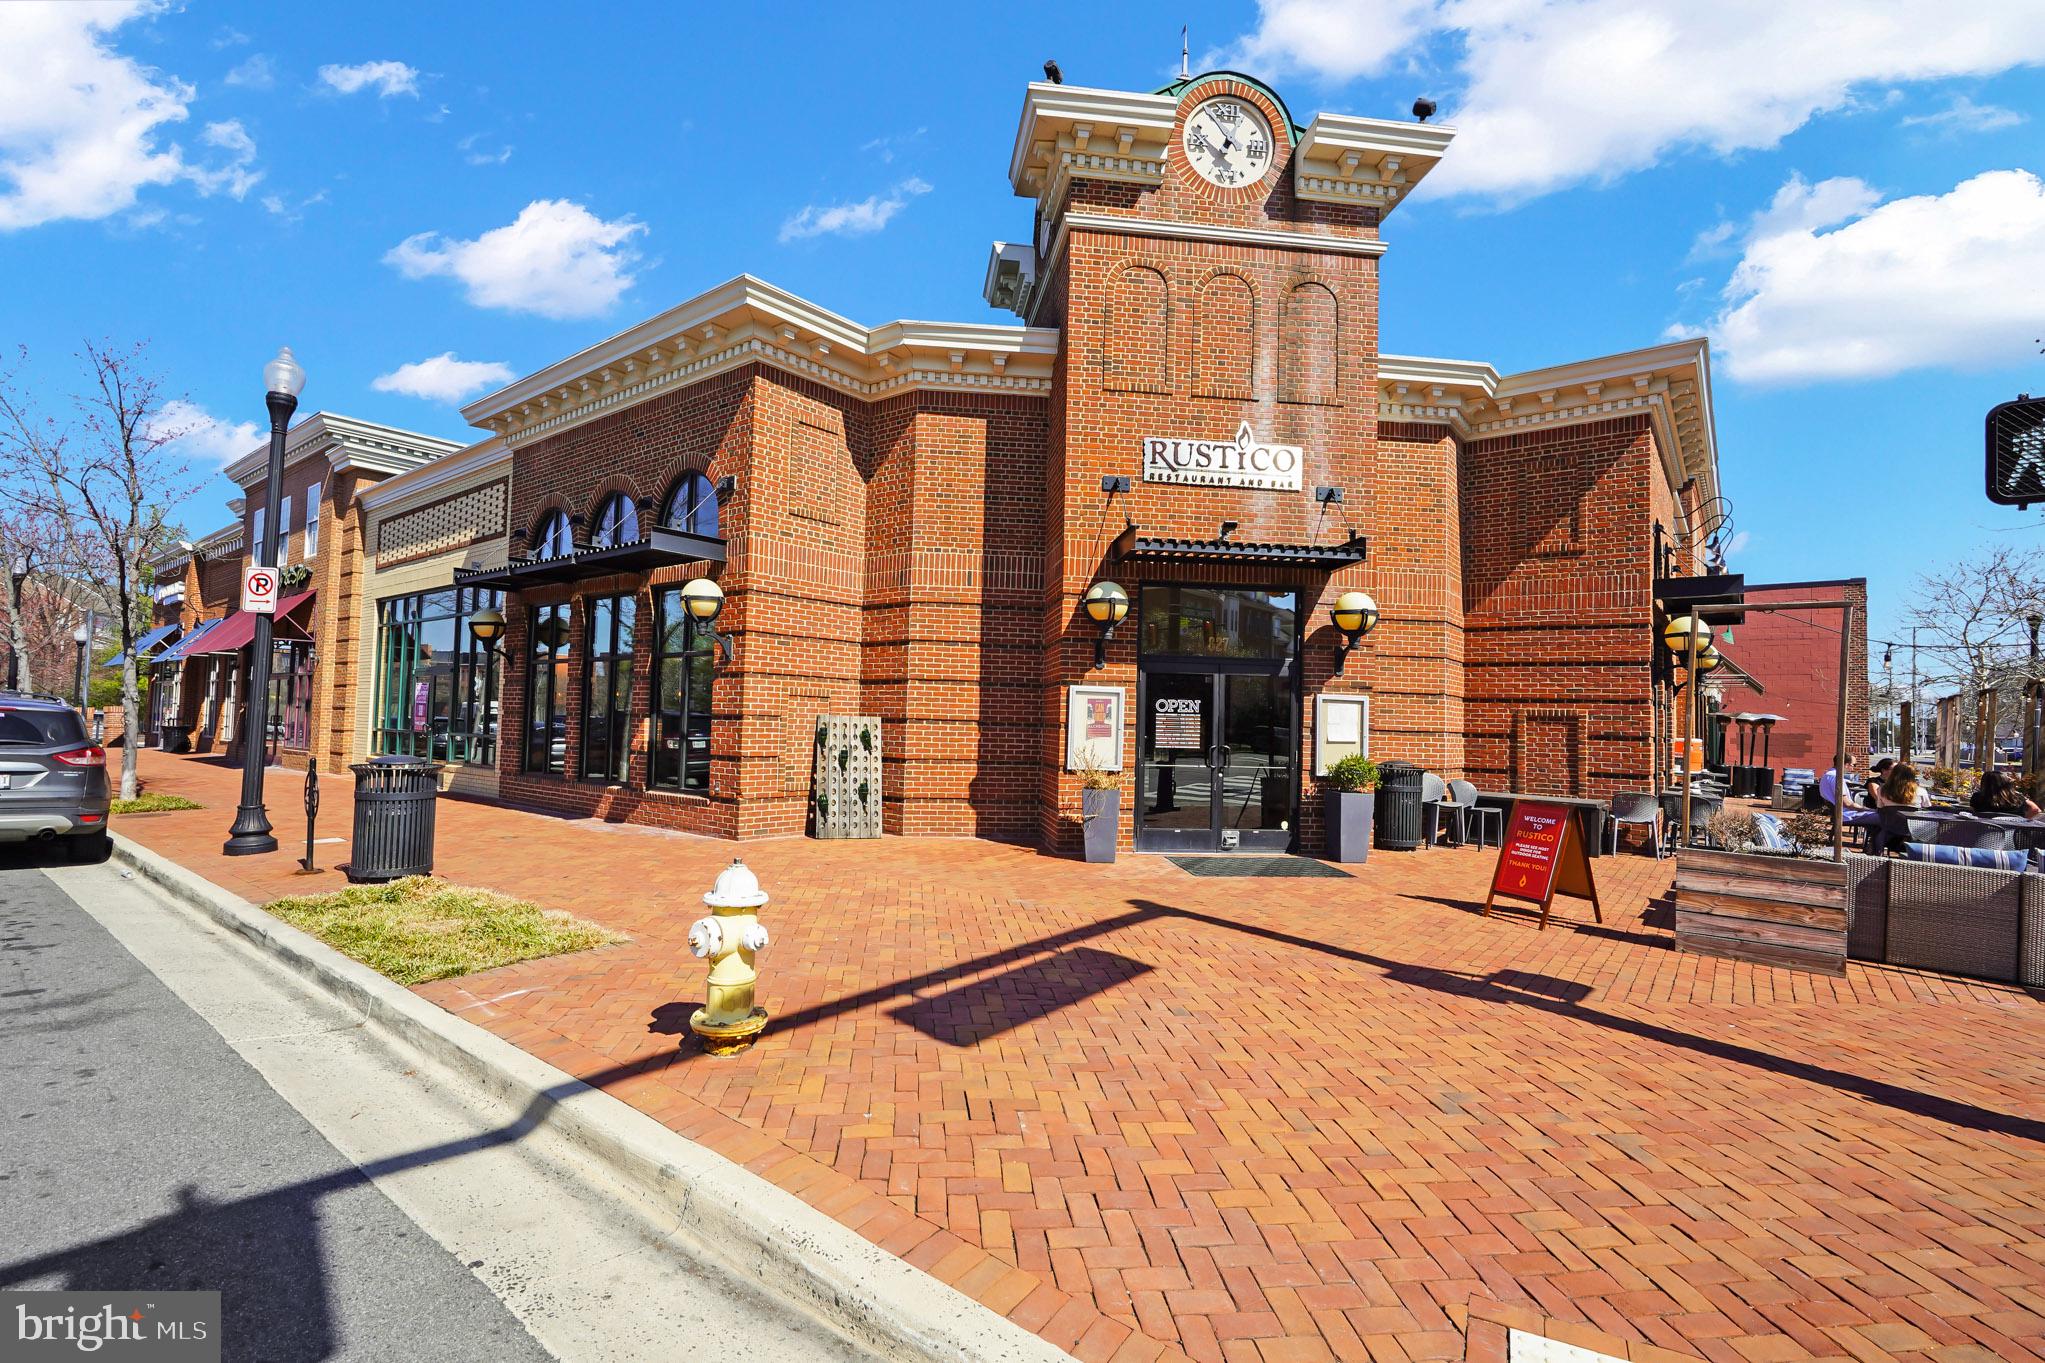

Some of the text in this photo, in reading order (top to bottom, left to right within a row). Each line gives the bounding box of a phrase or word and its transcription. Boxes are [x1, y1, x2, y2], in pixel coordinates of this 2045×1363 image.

[1149, 472, 1293, 489] RESTAURANT AND BAR
[1155, 698, 1202, 713] OPEN
[1524, 816, 1556, 824] WELCOME
[1516, 830, 1554, 841] RUSTICO
[1509, 860, 1530, 868] THANK
